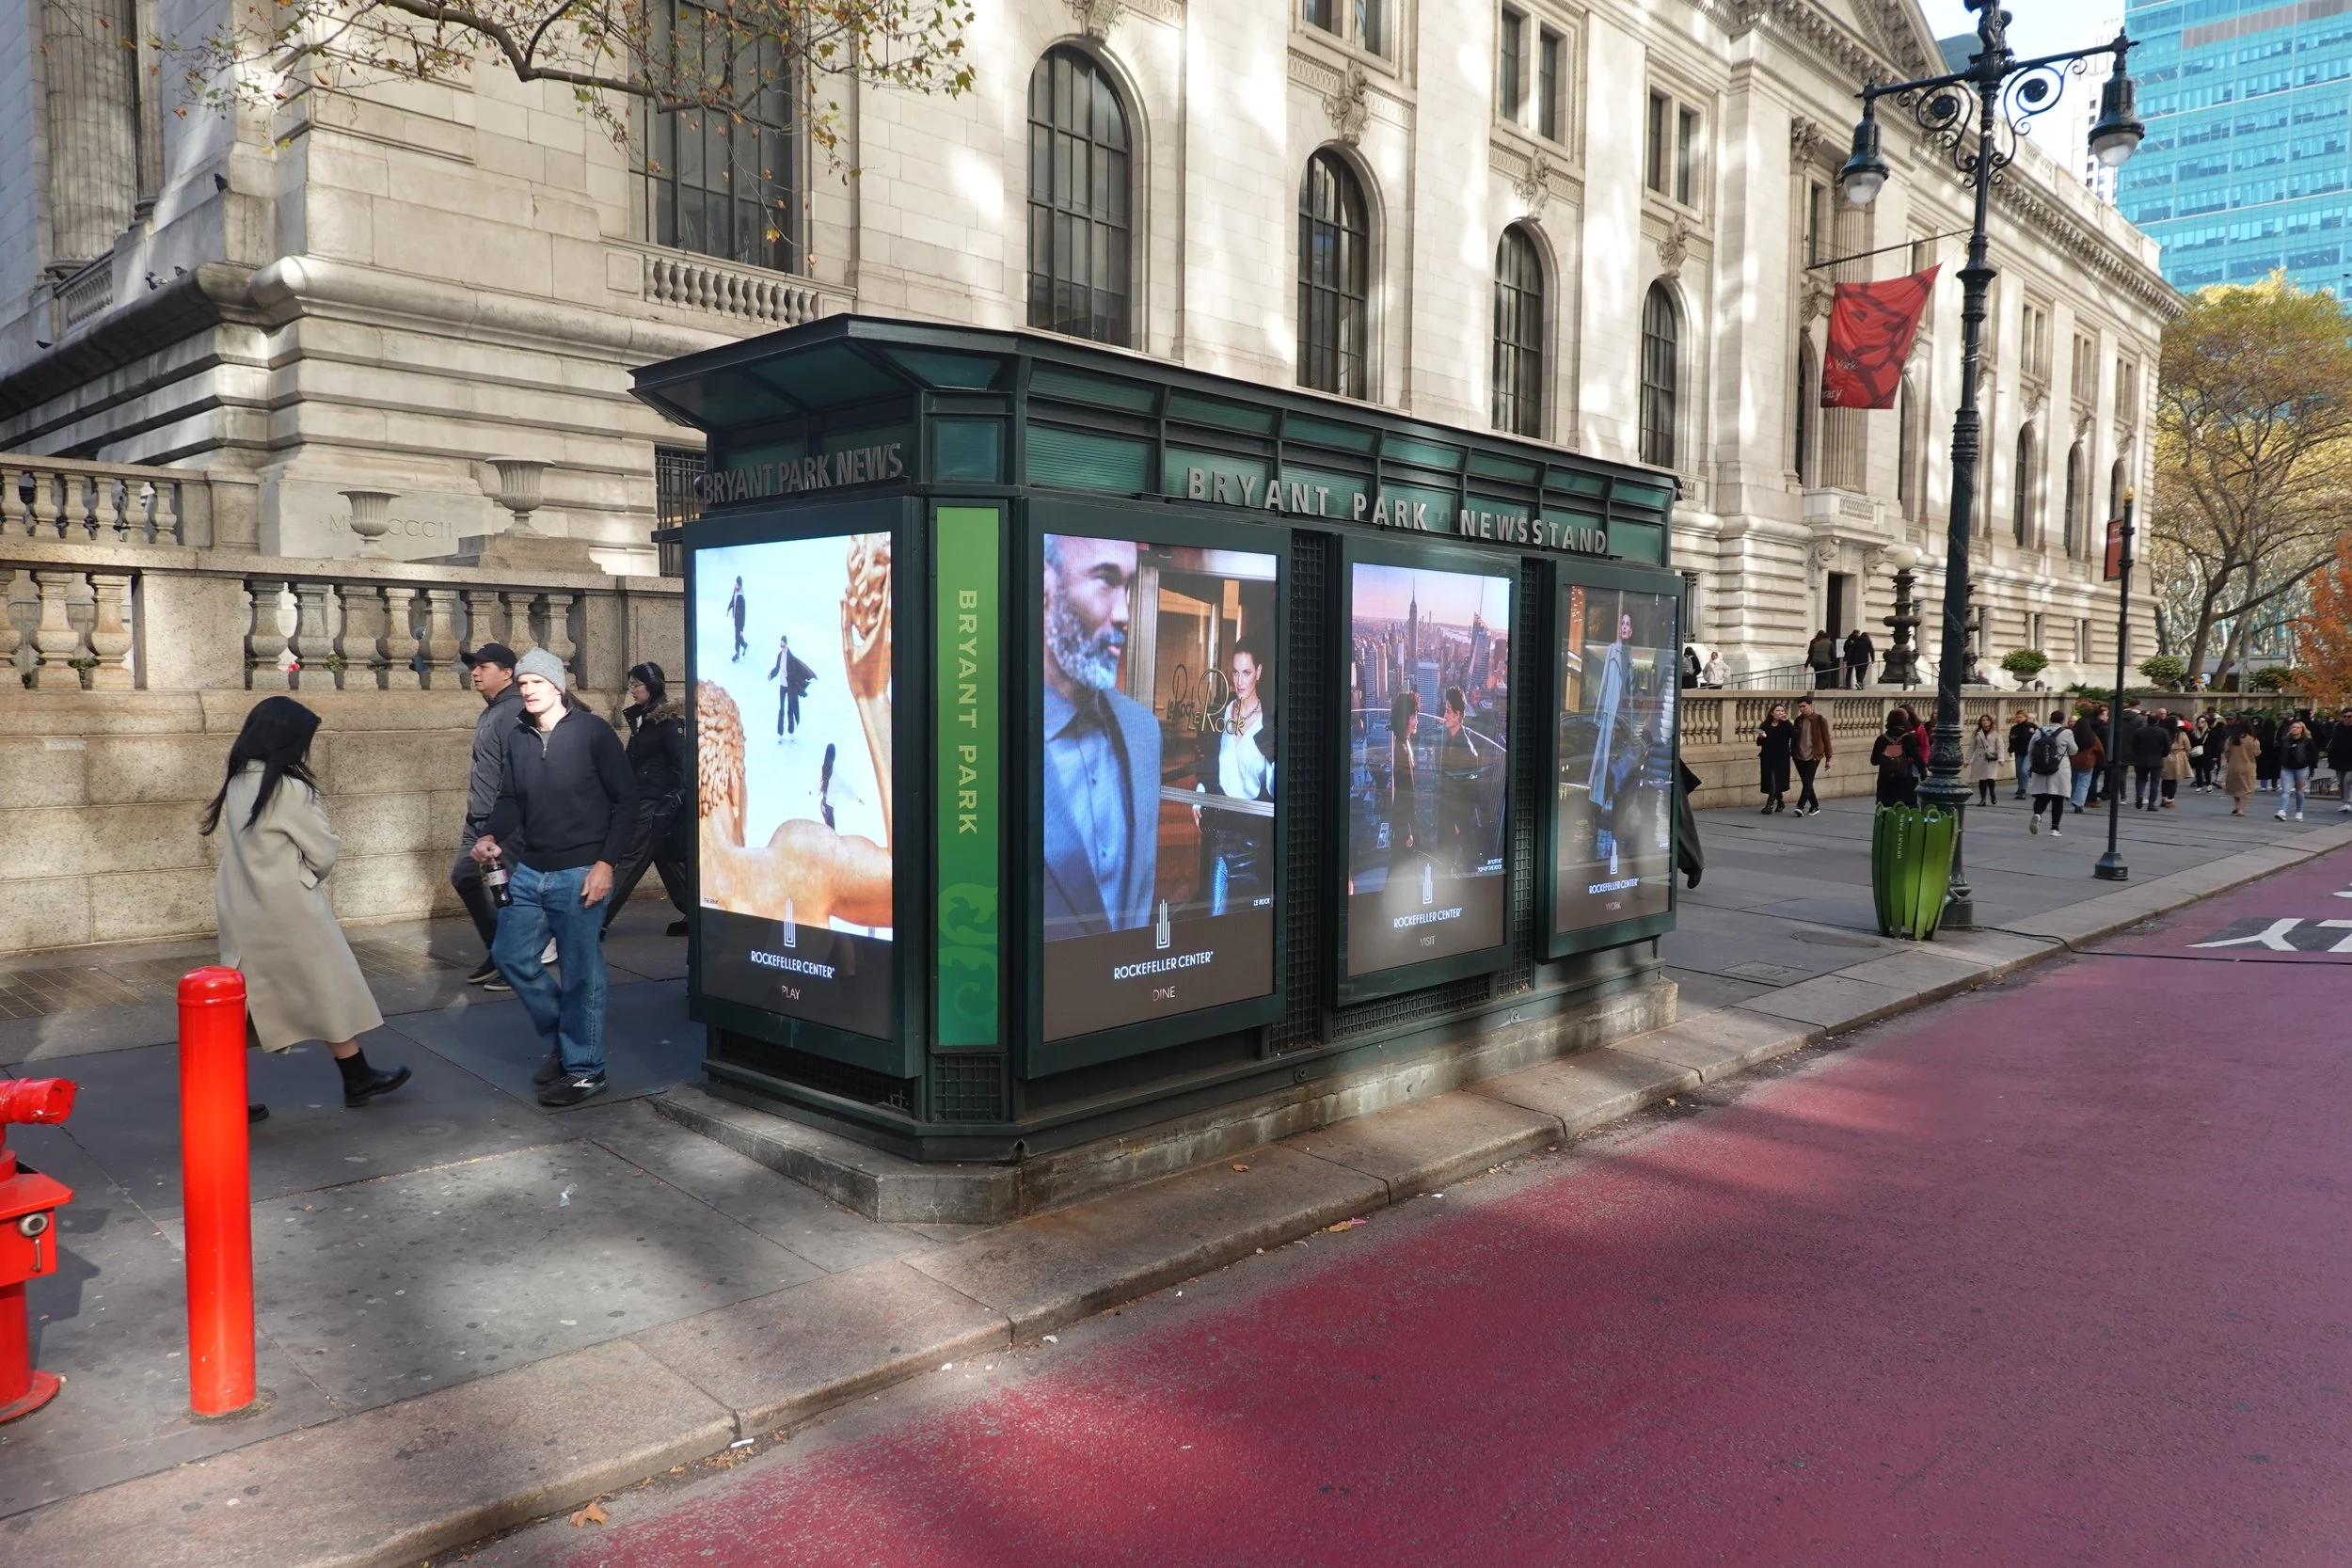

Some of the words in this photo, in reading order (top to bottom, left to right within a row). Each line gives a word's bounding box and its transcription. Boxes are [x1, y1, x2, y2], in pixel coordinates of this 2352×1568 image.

[703, 463, 775, 505] BRYANT
[778, 455, 832, 495] PARK
[835, 442, 903, 485] NEWS
[1187, 467, 1329, 516] BRYANT
[1352, 492, 1428, 531] PARK
[1459, 509, 1607, 554] NEWSSTAND
[329, 514, 453, 539] MCCCII
[958, 589, 977, 729] BRYANT
[958, 745, 977, 834] PARK
[1588, 880, 1621, 895] ROCKEFELLER
[1621, 878, 1638, 889] CENTER
[1393, 911, 1437, 928] ROCKEFELLER
[1438, 908, 1461, 922] CENTER
[1605, 901, 1622, 911] WORK
[1420, 935, 1436, 947] VISIT
[751, 950, 802, 973] ROCKEFELLER
[803, 960, 833, 979] CENTER
[1114, 957, 1177, 980] ROCKEFELLER
[1178, 951, 1212, 968] CENTER
[781, 985, 801, 1001] PLAY
[1152, 986, 1176, 1002] DINE
